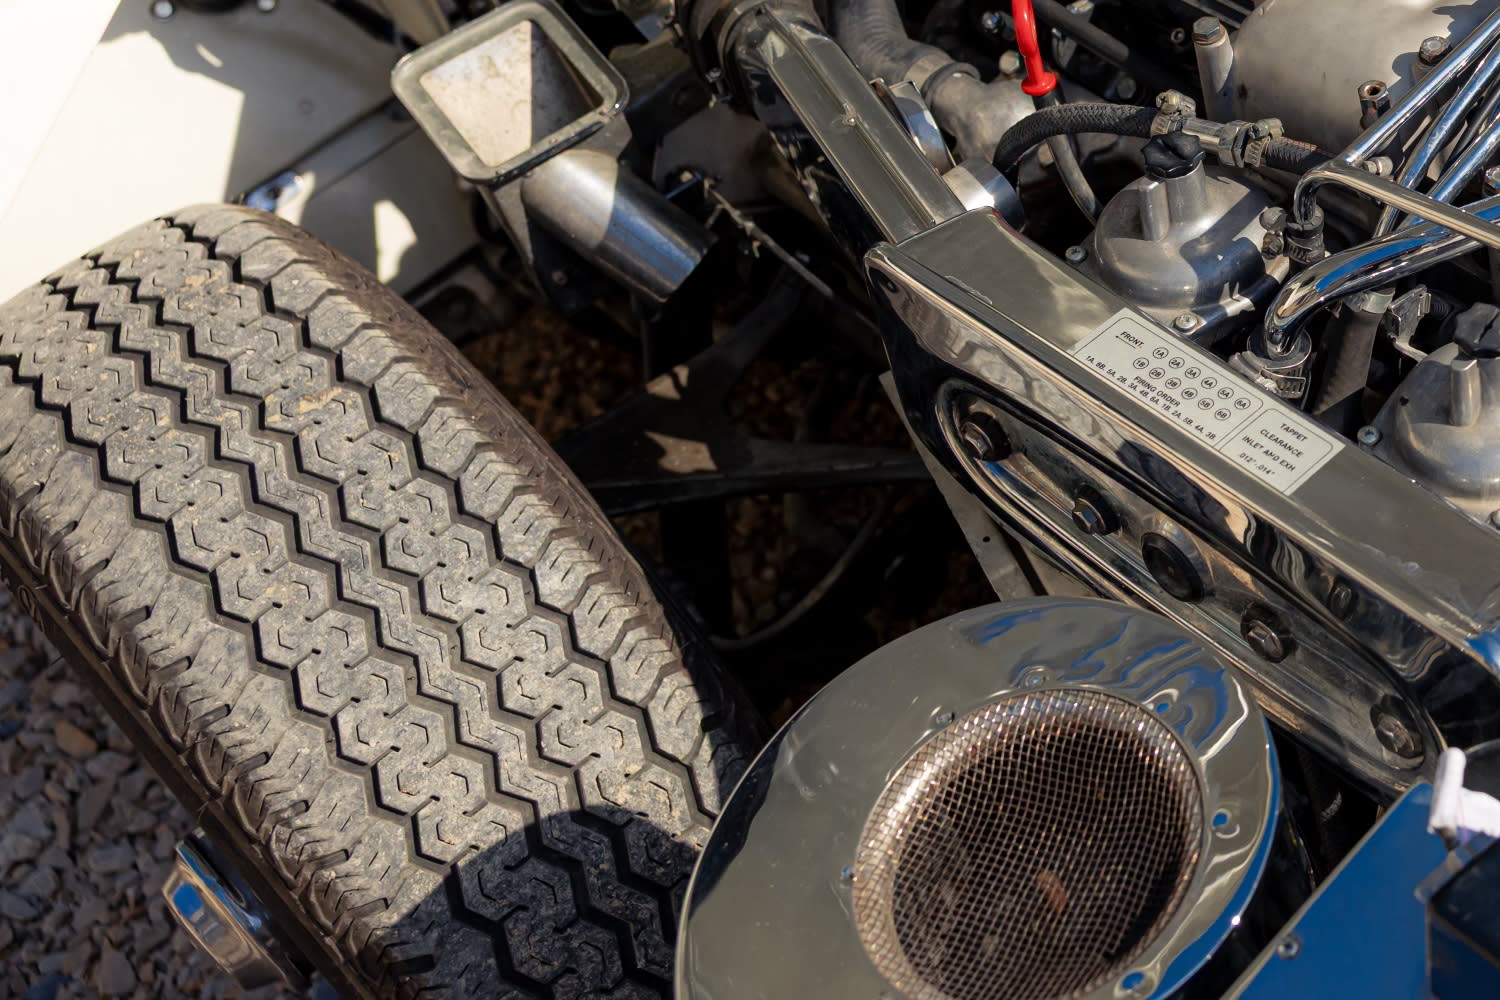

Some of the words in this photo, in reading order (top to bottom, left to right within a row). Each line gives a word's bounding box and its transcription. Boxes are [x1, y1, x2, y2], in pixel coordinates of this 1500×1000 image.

[1120, 331, 1145, 348] FRONT
[1134, 376, 1157, 392] FIRING
[1156, 391, 1181, 407] ORDER
[1260, 428, 1304, 458] CLEARANCE
[1280, 423, 1308, 441] TAPPET
[1241, 435, 1264, 449] INLET
[1263, 449, 1280, 461] AND
[1279, 459, 1296, 472] EXH
